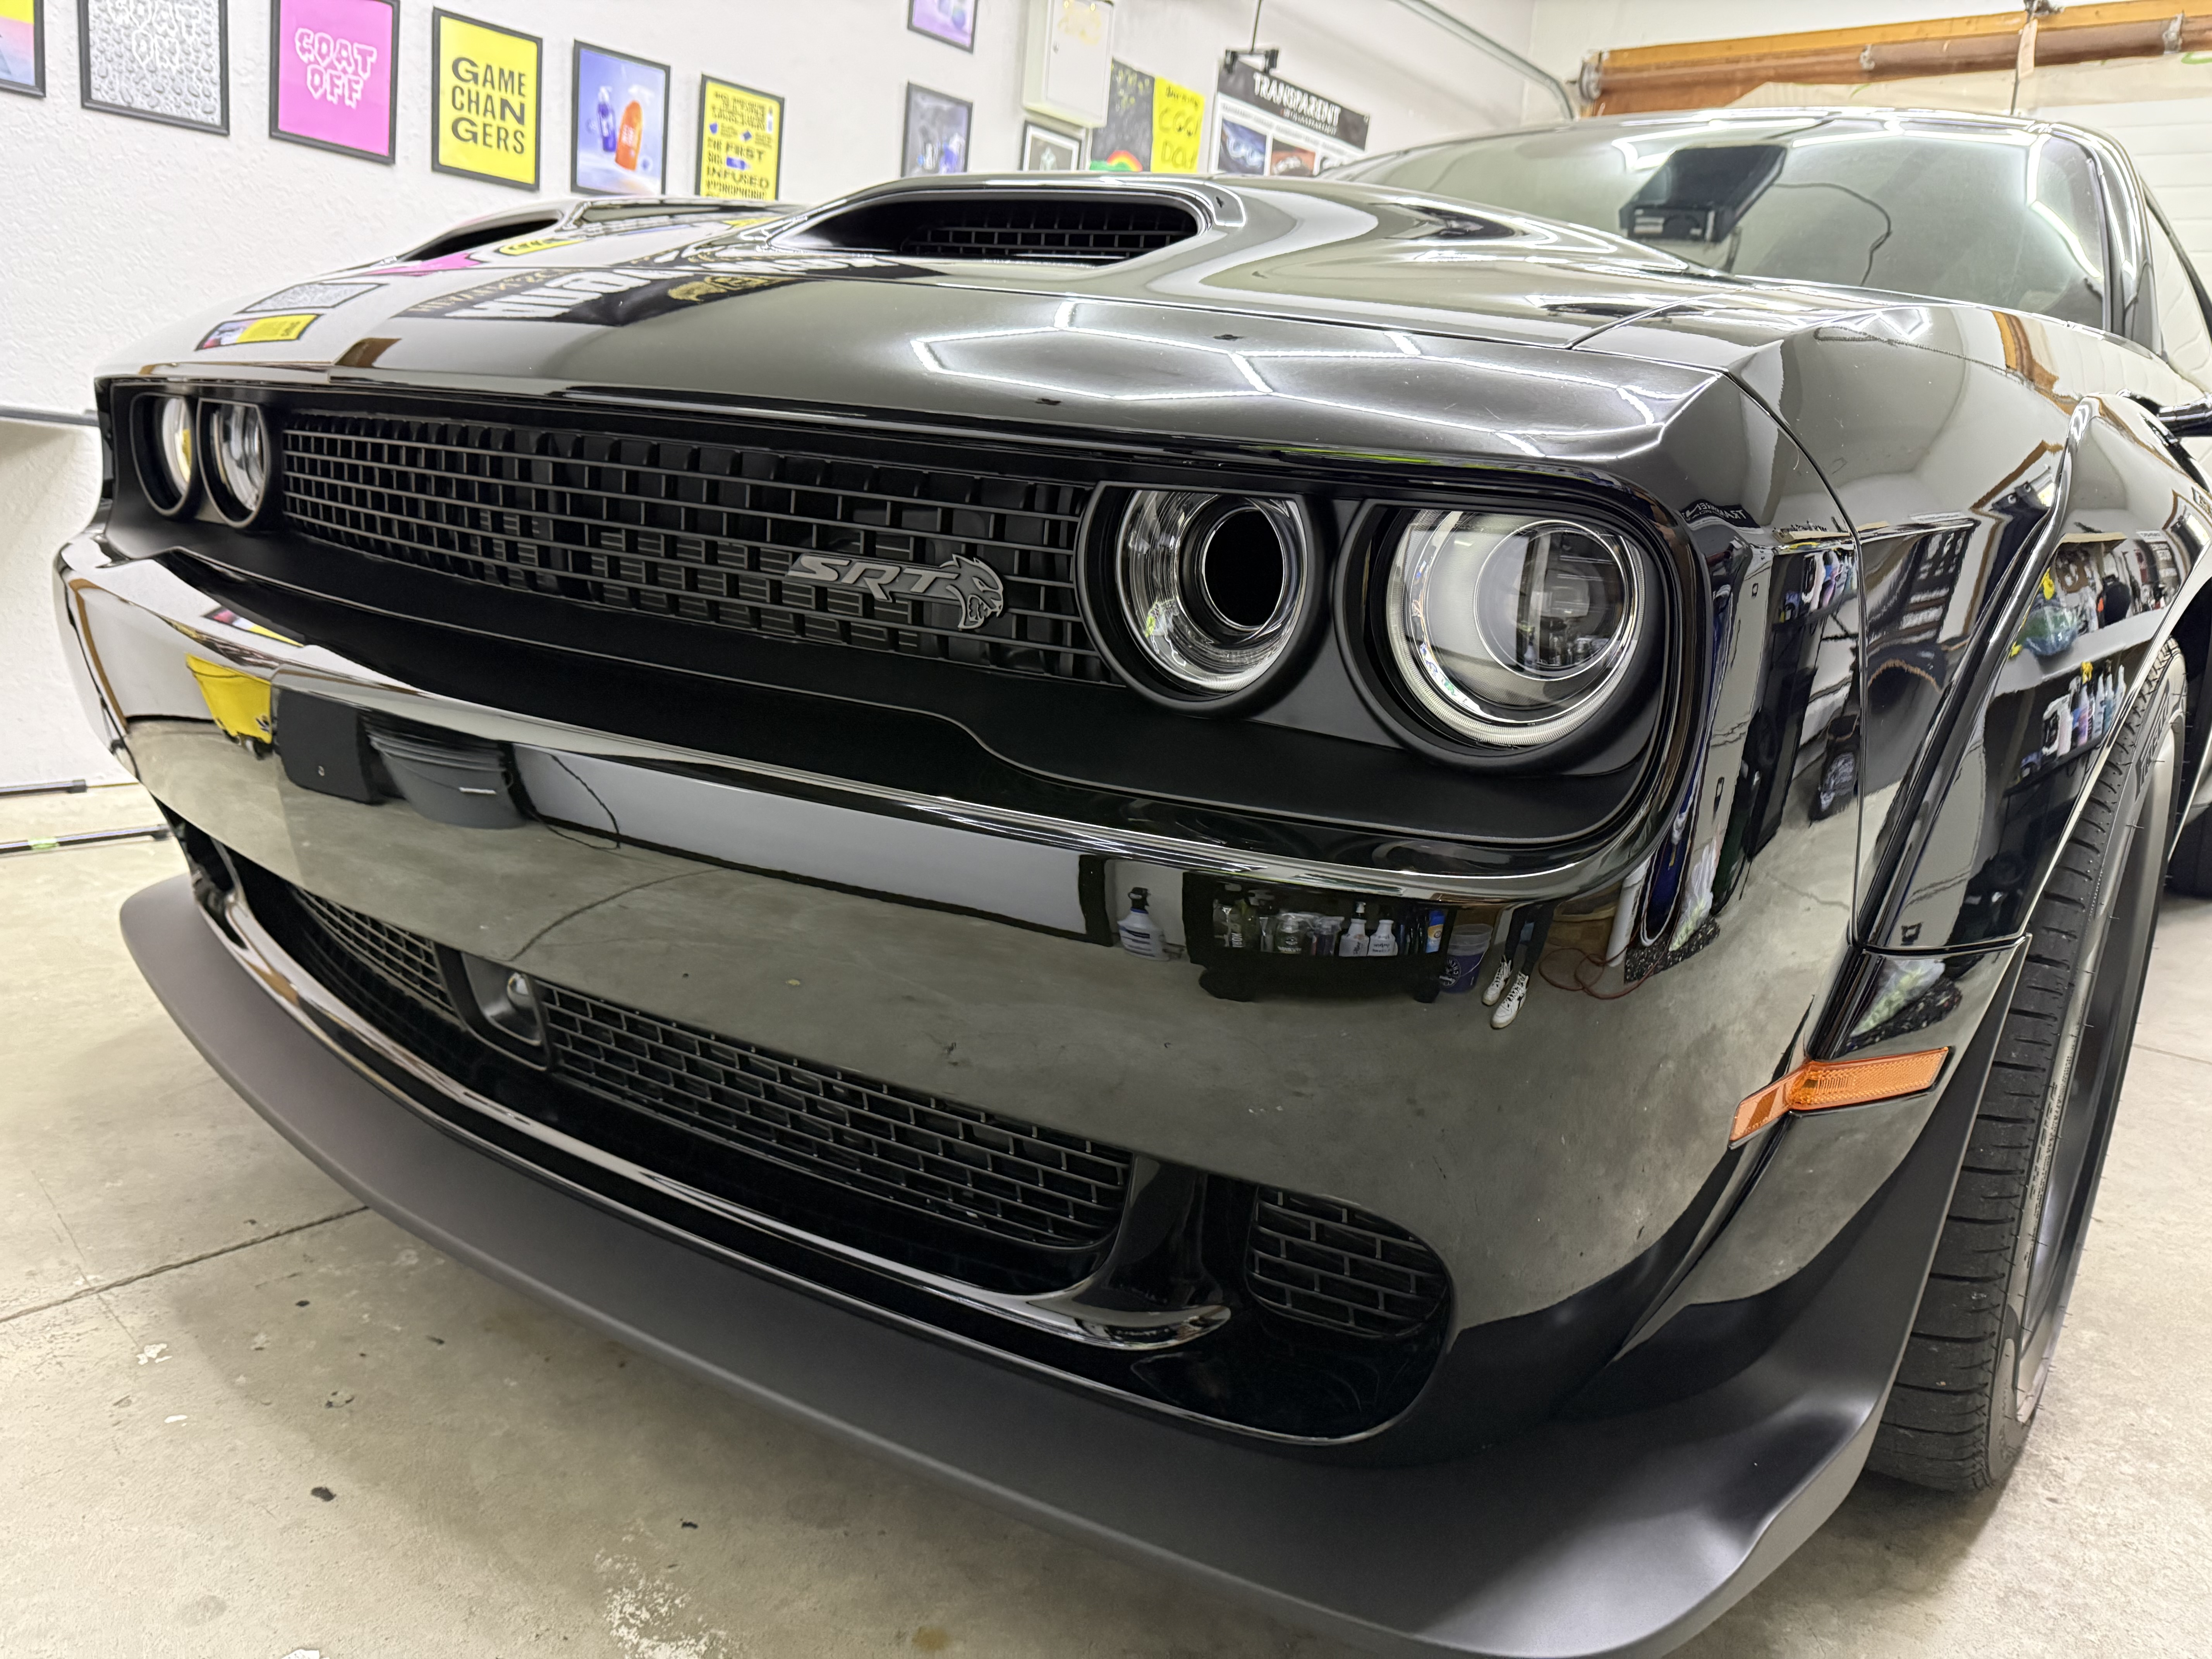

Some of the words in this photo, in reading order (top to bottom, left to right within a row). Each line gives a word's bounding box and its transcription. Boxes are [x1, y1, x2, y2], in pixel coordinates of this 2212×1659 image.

[132, 29, 179, 74] ON
[294, 27, 377, 80] COAT
[307, 64, 364, 109] OFF
[452, 57, 526, 98] GAME
[1253, 71, 1341, 127] TRANSPARENT
[452, 85, 526, 126] CHAN
[451, 117, 526, 154] GERS
[787, 555, 959, 601] SRT
